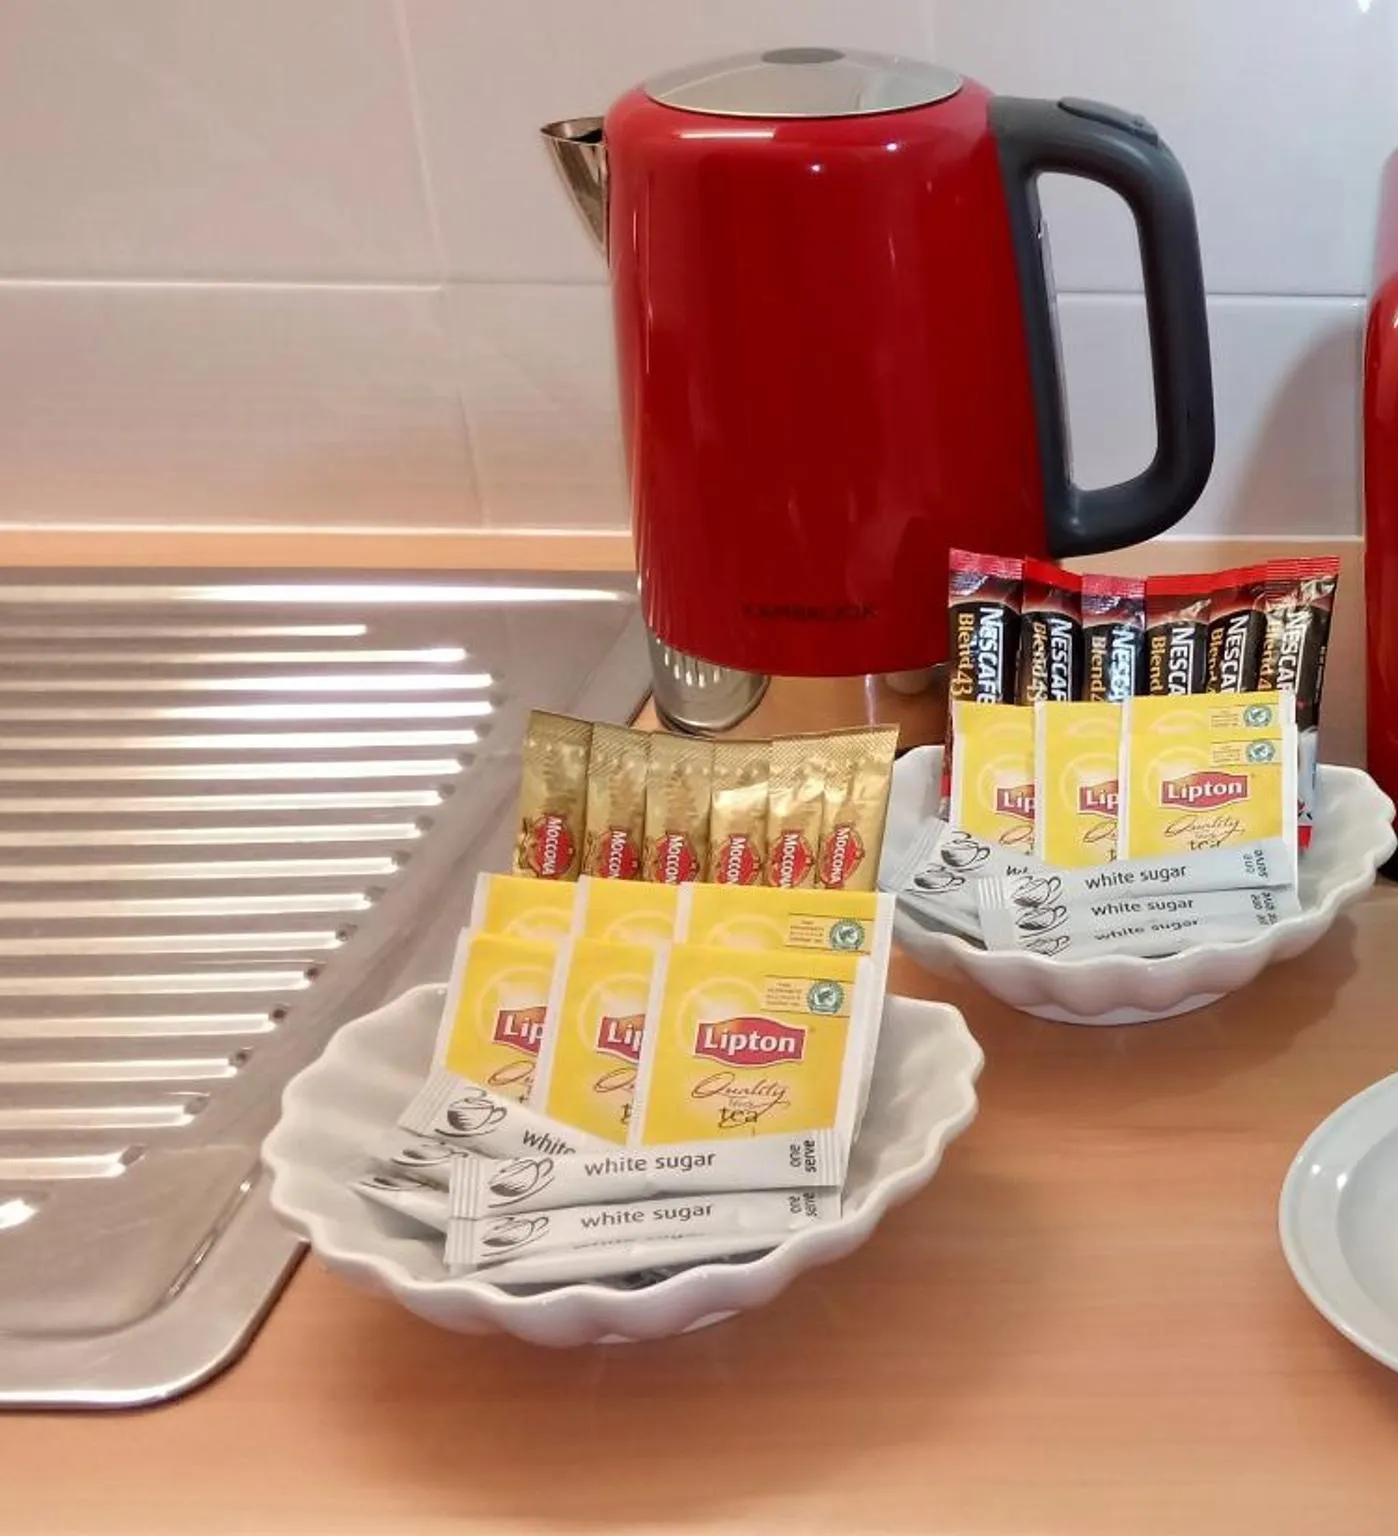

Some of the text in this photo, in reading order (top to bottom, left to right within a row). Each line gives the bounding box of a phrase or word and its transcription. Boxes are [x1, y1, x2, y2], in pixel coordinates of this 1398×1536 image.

[957, 613, 975, 669] Blend
[1049, 618, 1073, 703] NESCAF
[1091, 635, 1107, 691] Blend
[1109, 625, 1136, 702] NESCA
[1150, 635, 1167, 692] Blend
[1168, 627, 1195, 696] NESCA
[1003, 790, 1034, 813] Lip
[1086, 789, 1118, 810] Lip
[1167, 780, 1242, 803] Lipton
[1084, 866, 1186, 890] white sugar
[1091, 899, 1194, 917] white sugar
[503, 1014, 544, 1045] Lip
[702, 1025, 797, 1057] Lipton
[691, 1072, 791, 1115] Quality
[718, 1107, 759, 1128] tea
[584, 1152, 716, 1177] white sugar
[803, 1139, 817, 1173] serve
[580, 1203, 714, 1228] white sugar
